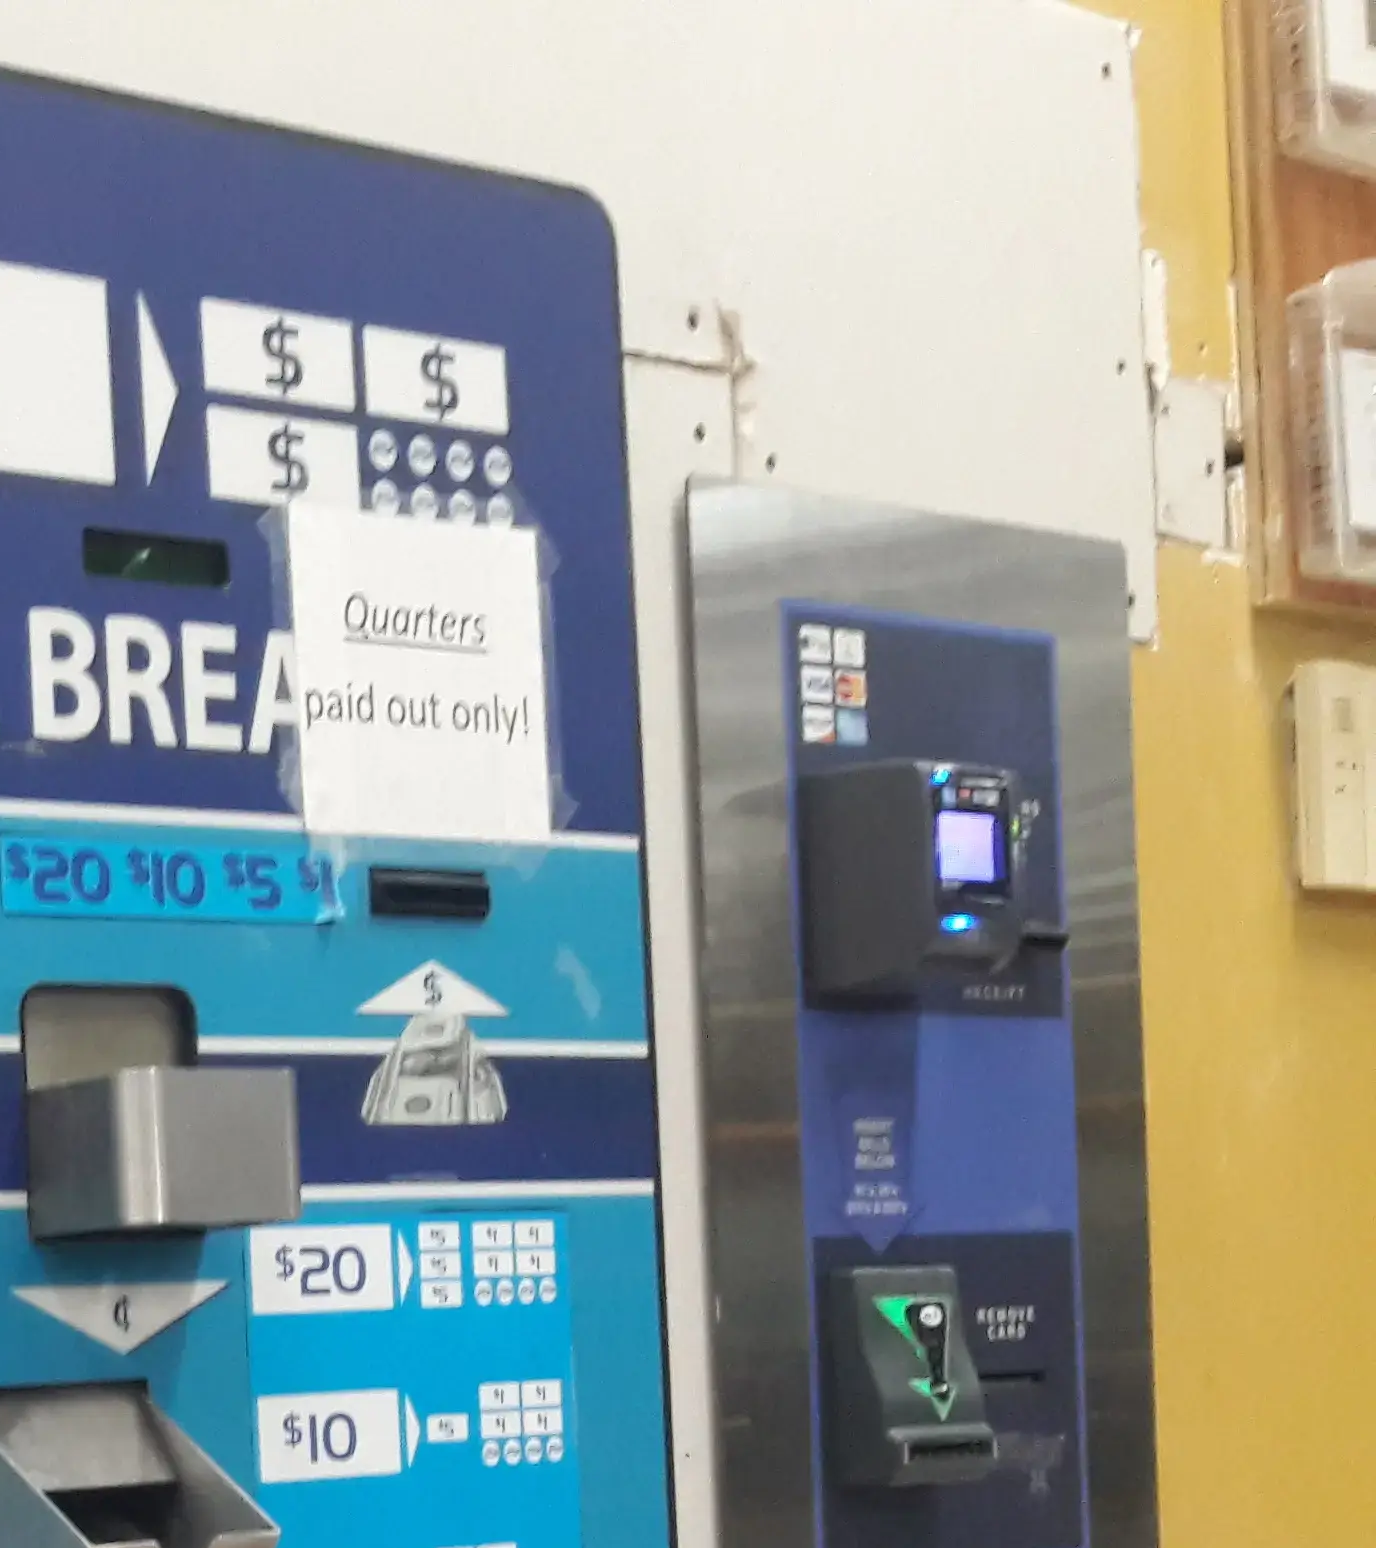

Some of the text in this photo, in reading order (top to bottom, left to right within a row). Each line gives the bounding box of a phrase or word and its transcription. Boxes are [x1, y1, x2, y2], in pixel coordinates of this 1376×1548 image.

[343, 589, 487, 645] Quarters
[304, 681, 530, 745] paid out only!
[6, 841, 112, 906] $20
[124, 845, 206, 909] $10
[221, 850, 283, 911] $5
[274, 1244, 367, 1297] $20
[282, 1409, 357, 1464] $10
